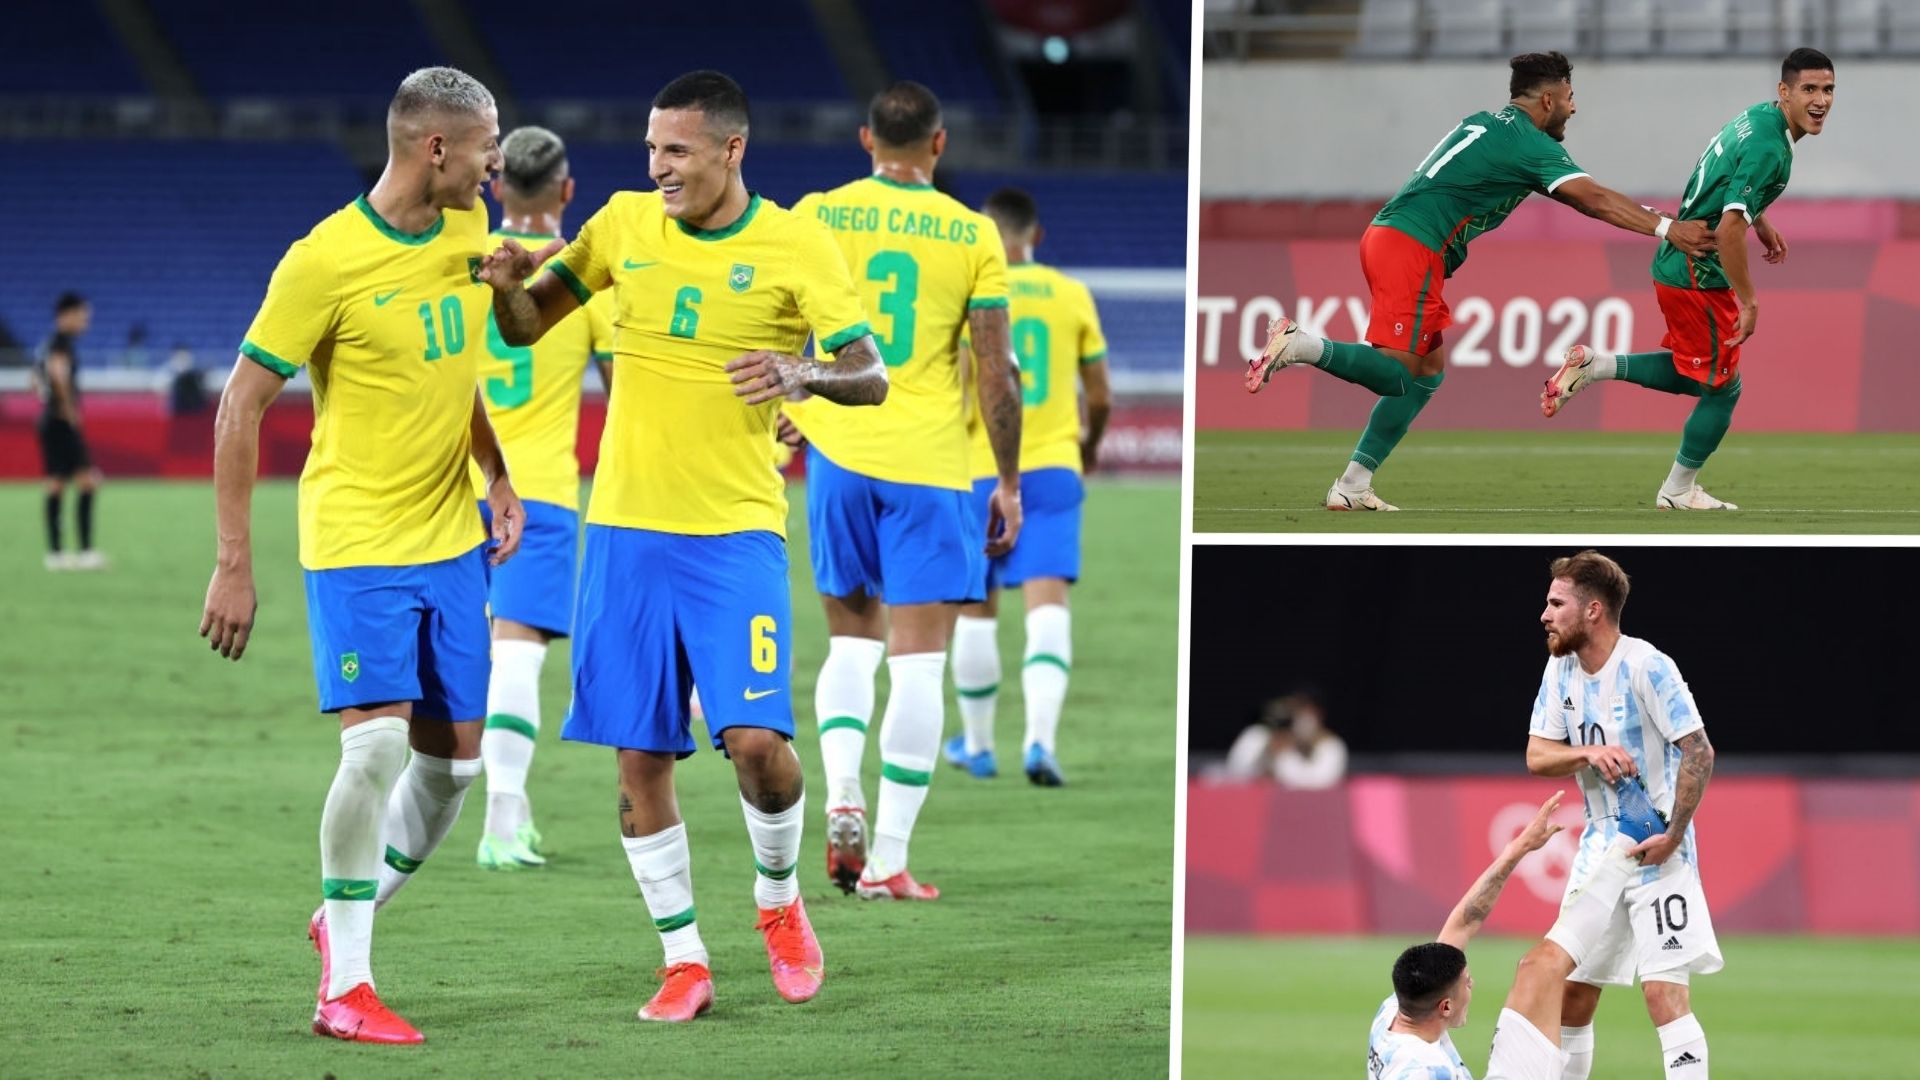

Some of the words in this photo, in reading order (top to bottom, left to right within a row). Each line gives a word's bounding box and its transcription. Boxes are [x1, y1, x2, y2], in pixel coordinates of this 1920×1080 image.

[817, 205, 879, 232] DIEGO
[888, 208, 978, 245] CARLOS
[418, 295, 465, 361] 10
[669, 286, 703, 339] 6
[866, 250, 919, 367] 3
[1197, 295, 1372, 367] TOKY
[1450, 295, 1634, 368] 2020
[1012, 317, 1049, 406] 9
[751, 615, 777, 673] 6
[1578, 721, 1606, 746] 10
[1650, 894, 1688, 935] 10
